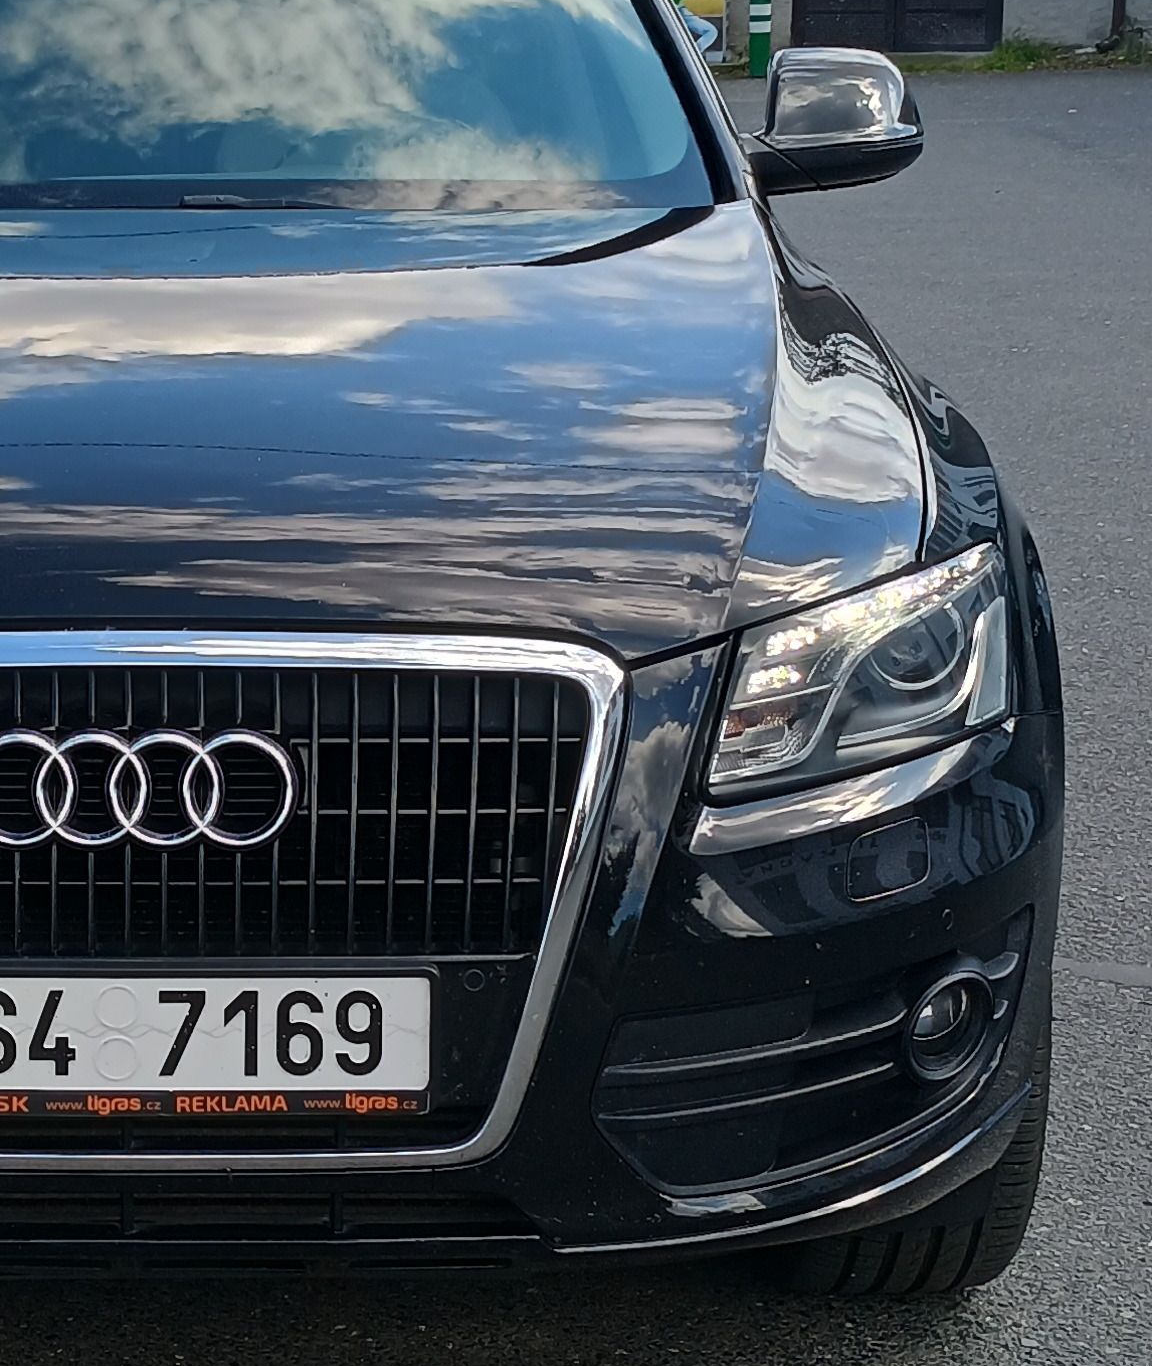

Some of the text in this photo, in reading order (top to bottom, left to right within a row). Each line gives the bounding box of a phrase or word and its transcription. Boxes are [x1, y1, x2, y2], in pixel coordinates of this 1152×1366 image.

[158, 989, 384, 1077] 7169
[45, 1092, 162, 1115] www.tigras.cz
[176, 1094, 289, 1113] REKLAMA
[303, 1092, 419, 1114] www.tigras.cz
